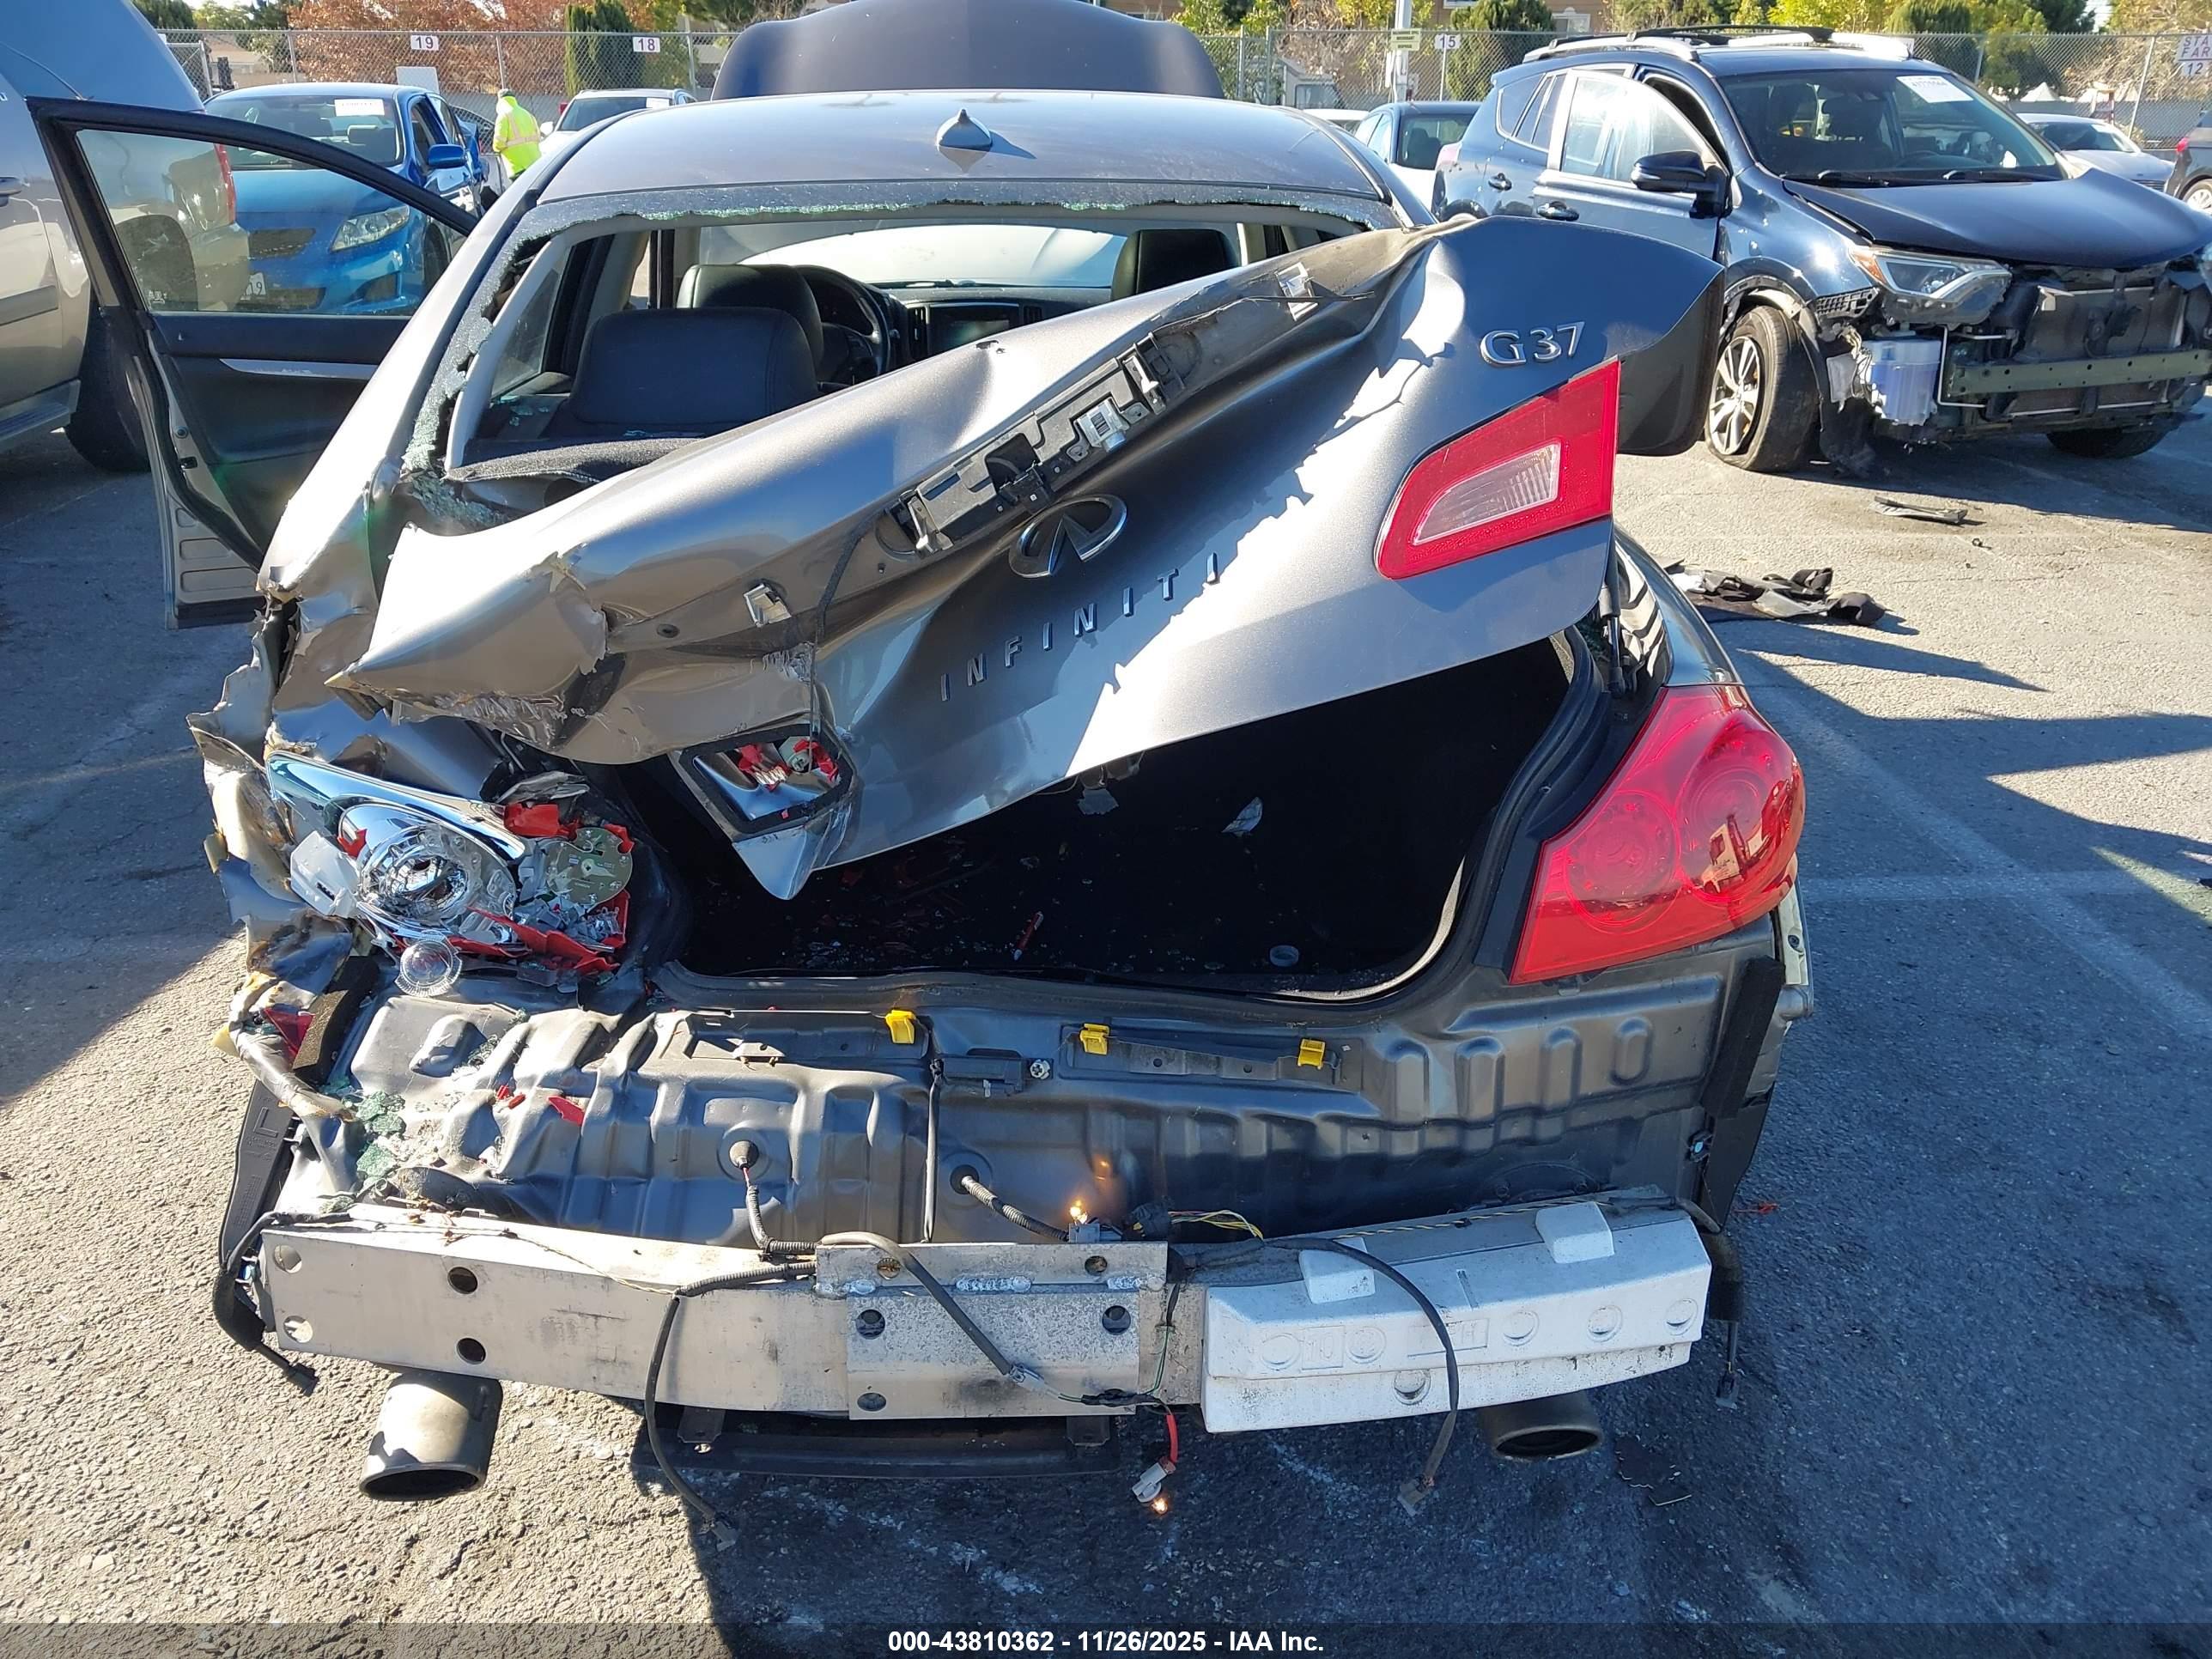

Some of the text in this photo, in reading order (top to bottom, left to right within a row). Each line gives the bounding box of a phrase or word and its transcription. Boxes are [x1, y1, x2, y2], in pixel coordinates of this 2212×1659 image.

[416, 36, 434, 49] 19
[638, 38, 655, 52] 18
[1439, 35, 1456, 48] 15
[2184, 36, 2209, 46] STA
[2181, 46, 2210, 58] FAR
[2188, 62, 2203, 76] 12
[1480, 321, 1586, 366] G37
[939, 551, 1219, 702] INFINITI
